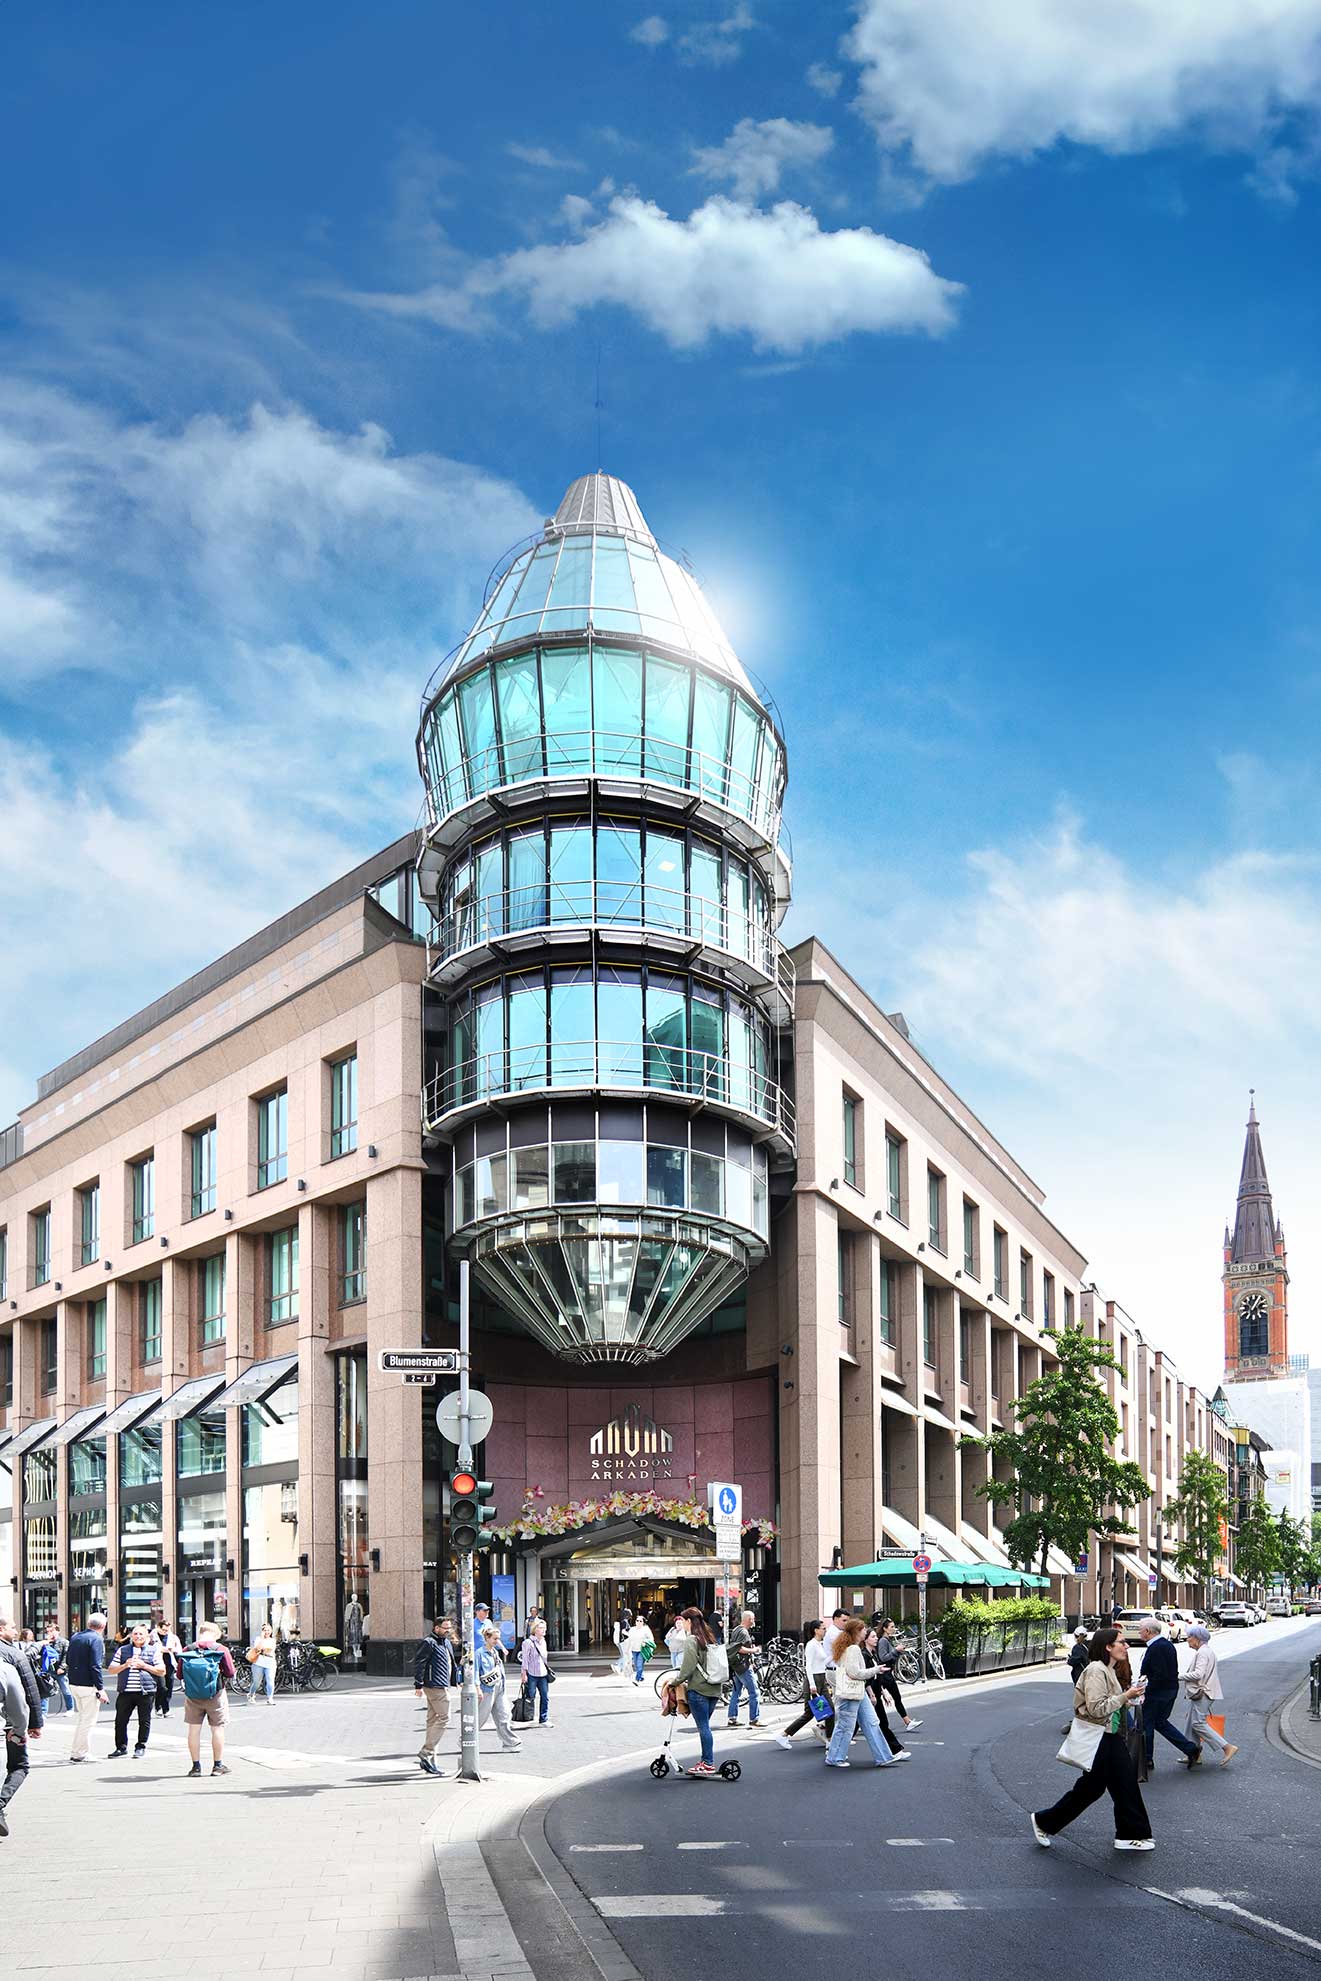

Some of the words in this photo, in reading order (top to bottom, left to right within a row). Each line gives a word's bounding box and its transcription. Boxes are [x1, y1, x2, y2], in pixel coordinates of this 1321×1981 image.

[389, 1355, 448, 1368] Blumenstraße
[591, 1459, 673, 1468] SCHADOW
[591, 1470, 672, 1479] ARKADEN
[190, 1558, 222, 1567] REPEAT
